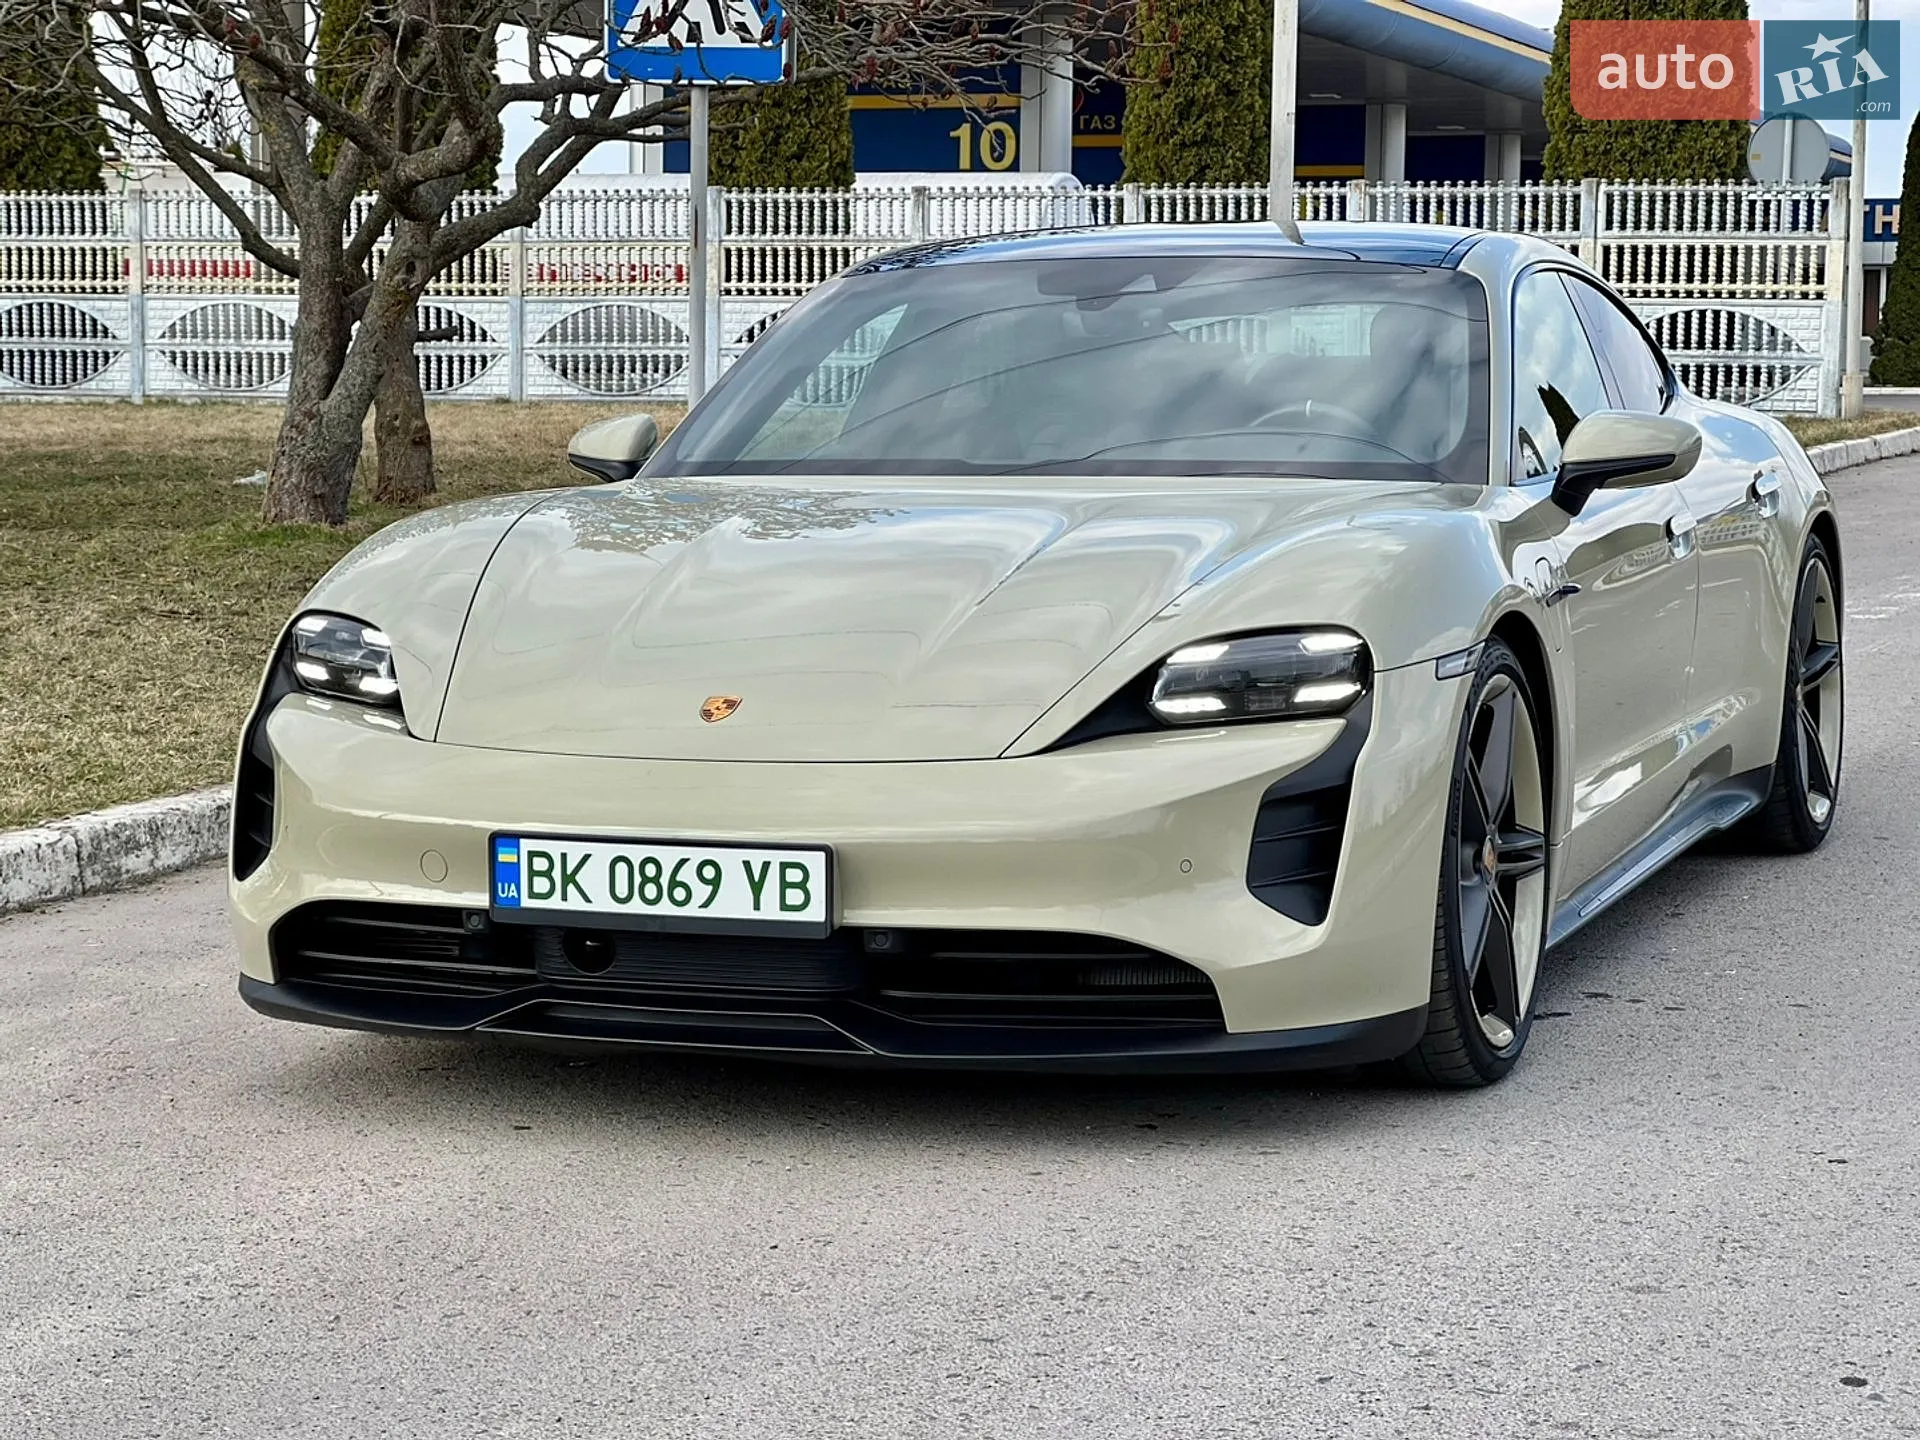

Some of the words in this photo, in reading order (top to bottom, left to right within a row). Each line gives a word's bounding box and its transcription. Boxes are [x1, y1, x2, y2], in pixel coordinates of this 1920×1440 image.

[1079, 114, 1116, 130] ГАЗ
[950, 121, 1017, 171] 10
[497, 882, 519, 899] UA
[526, 849, 593, 904] BK
[608, 854, 723, 909] 0869
[742, 860, 812, 912] YB
